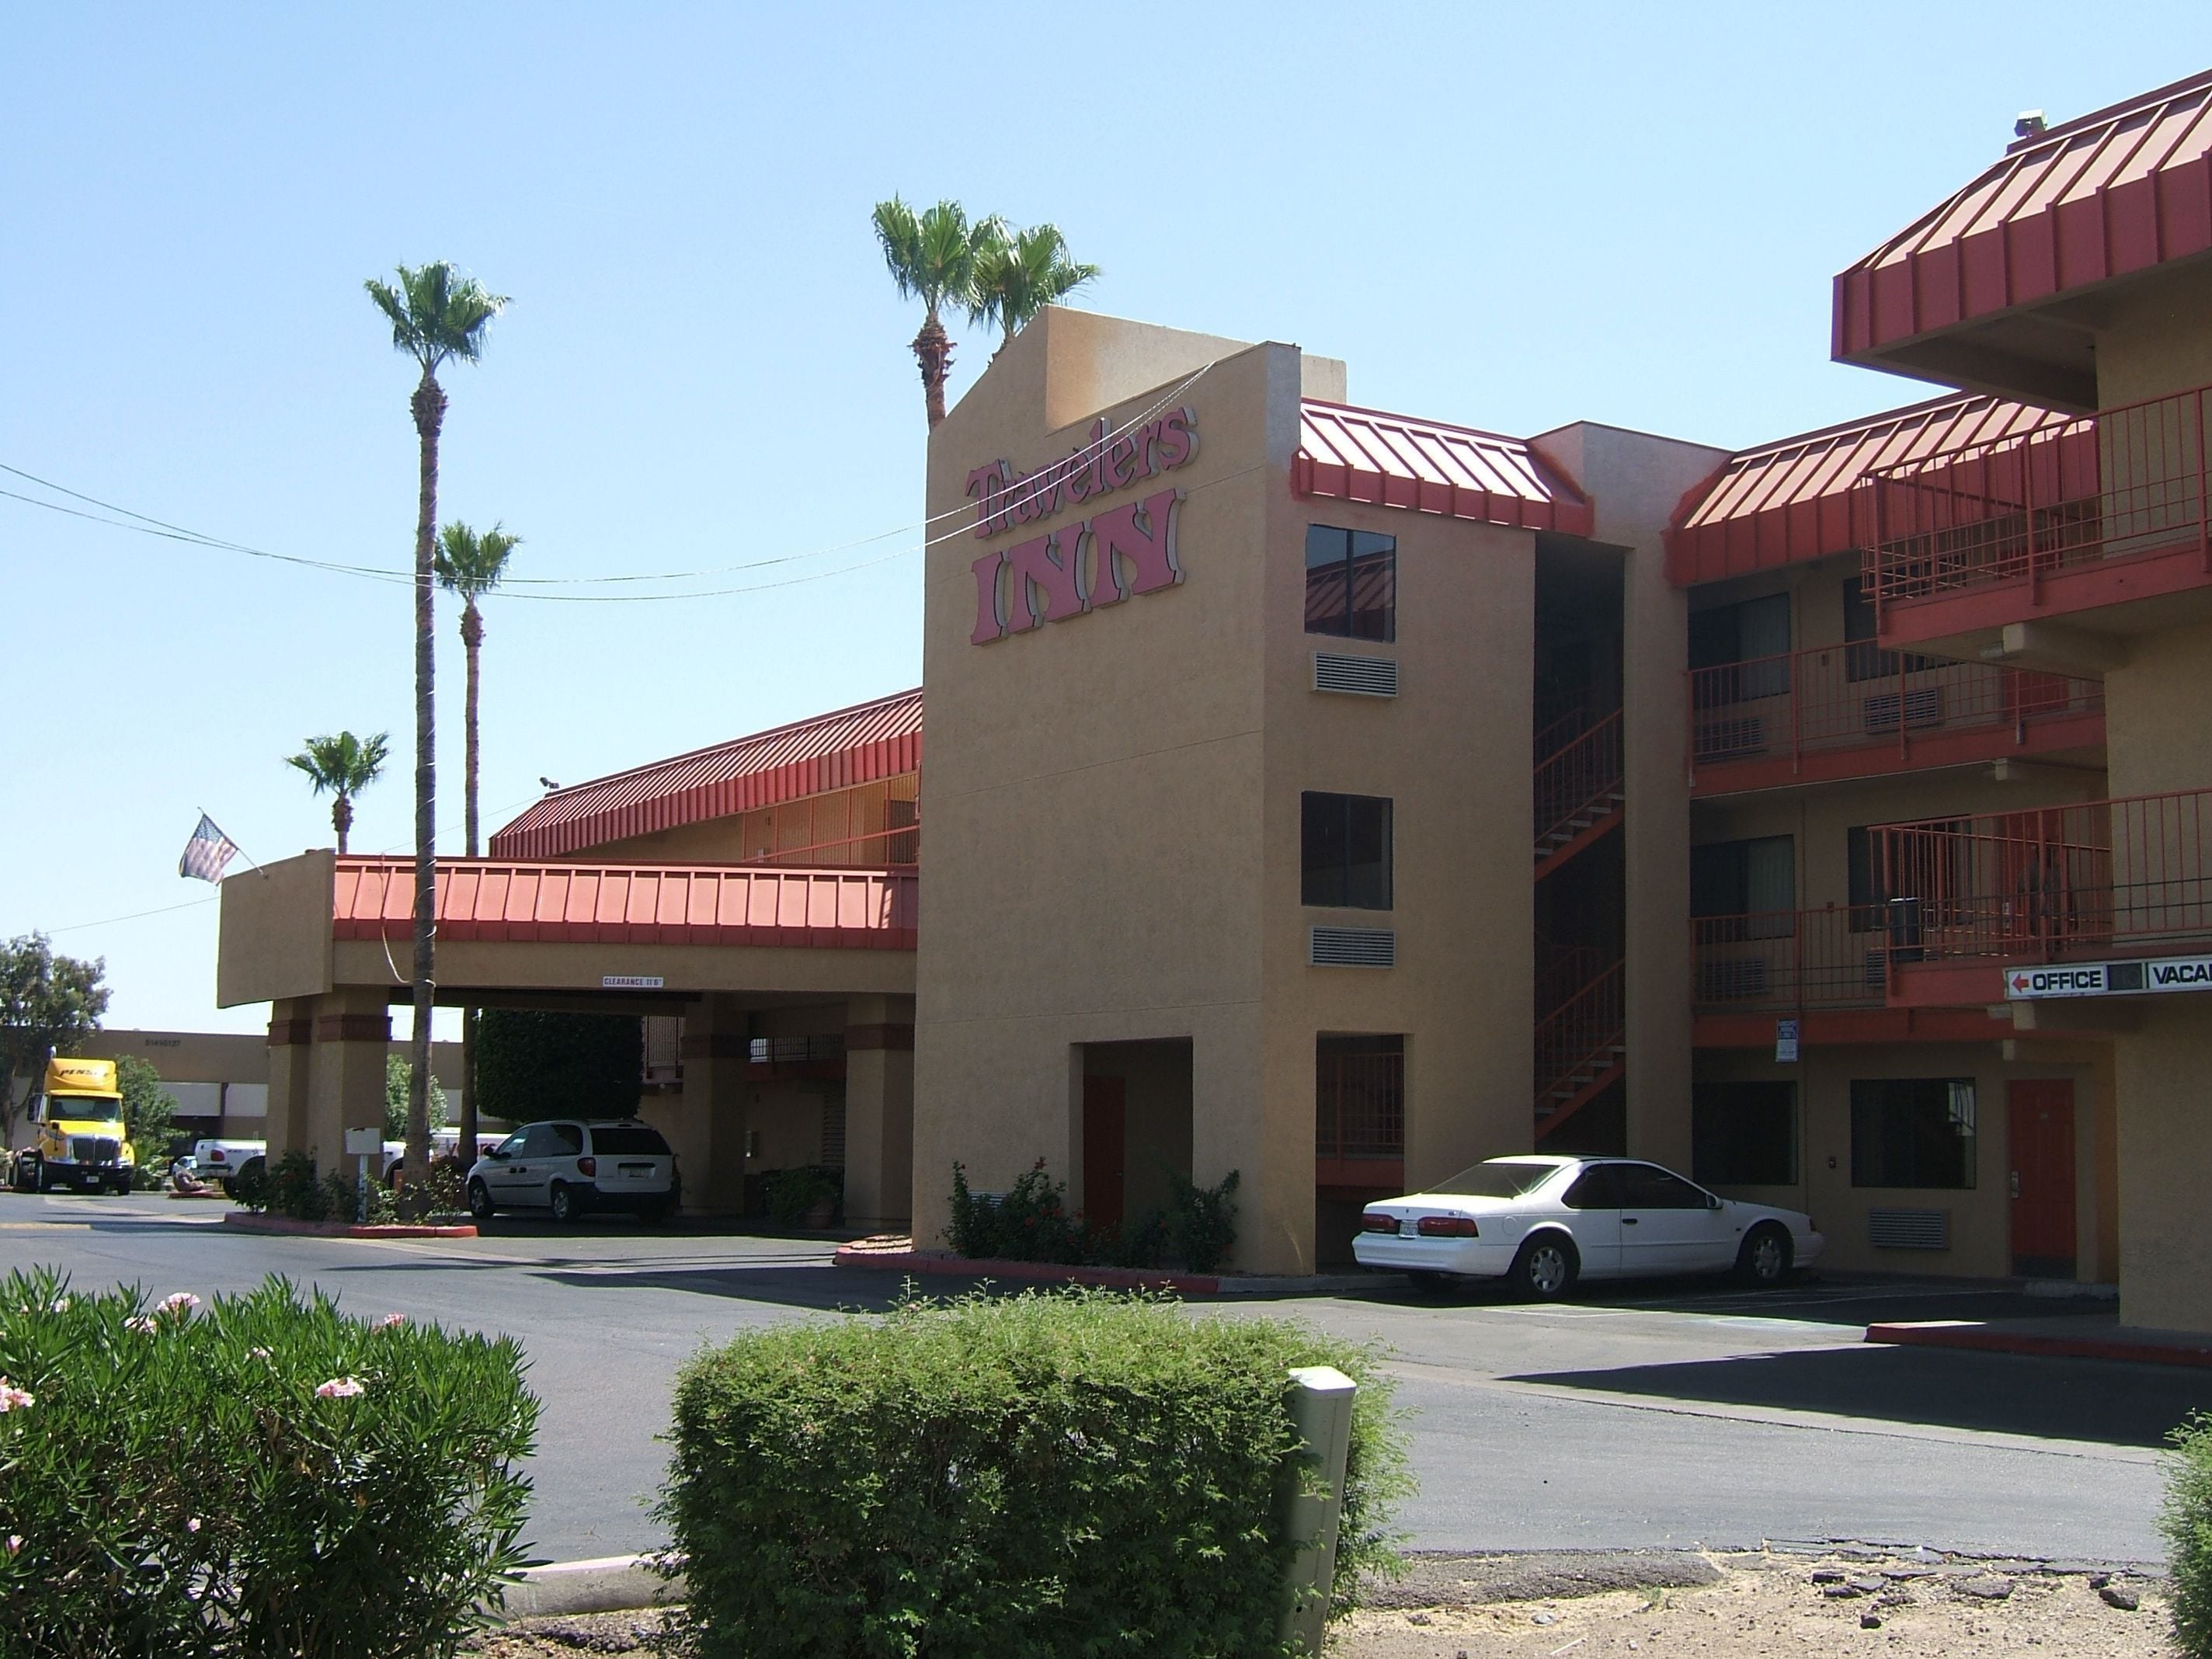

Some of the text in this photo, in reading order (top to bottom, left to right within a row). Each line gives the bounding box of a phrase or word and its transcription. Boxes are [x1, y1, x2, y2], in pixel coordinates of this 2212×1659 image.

[965, 406, 1198, 539] Travelers
[971, 487, 1185, 645] INN
[2032, 970, 2102, 990] OFFICE
